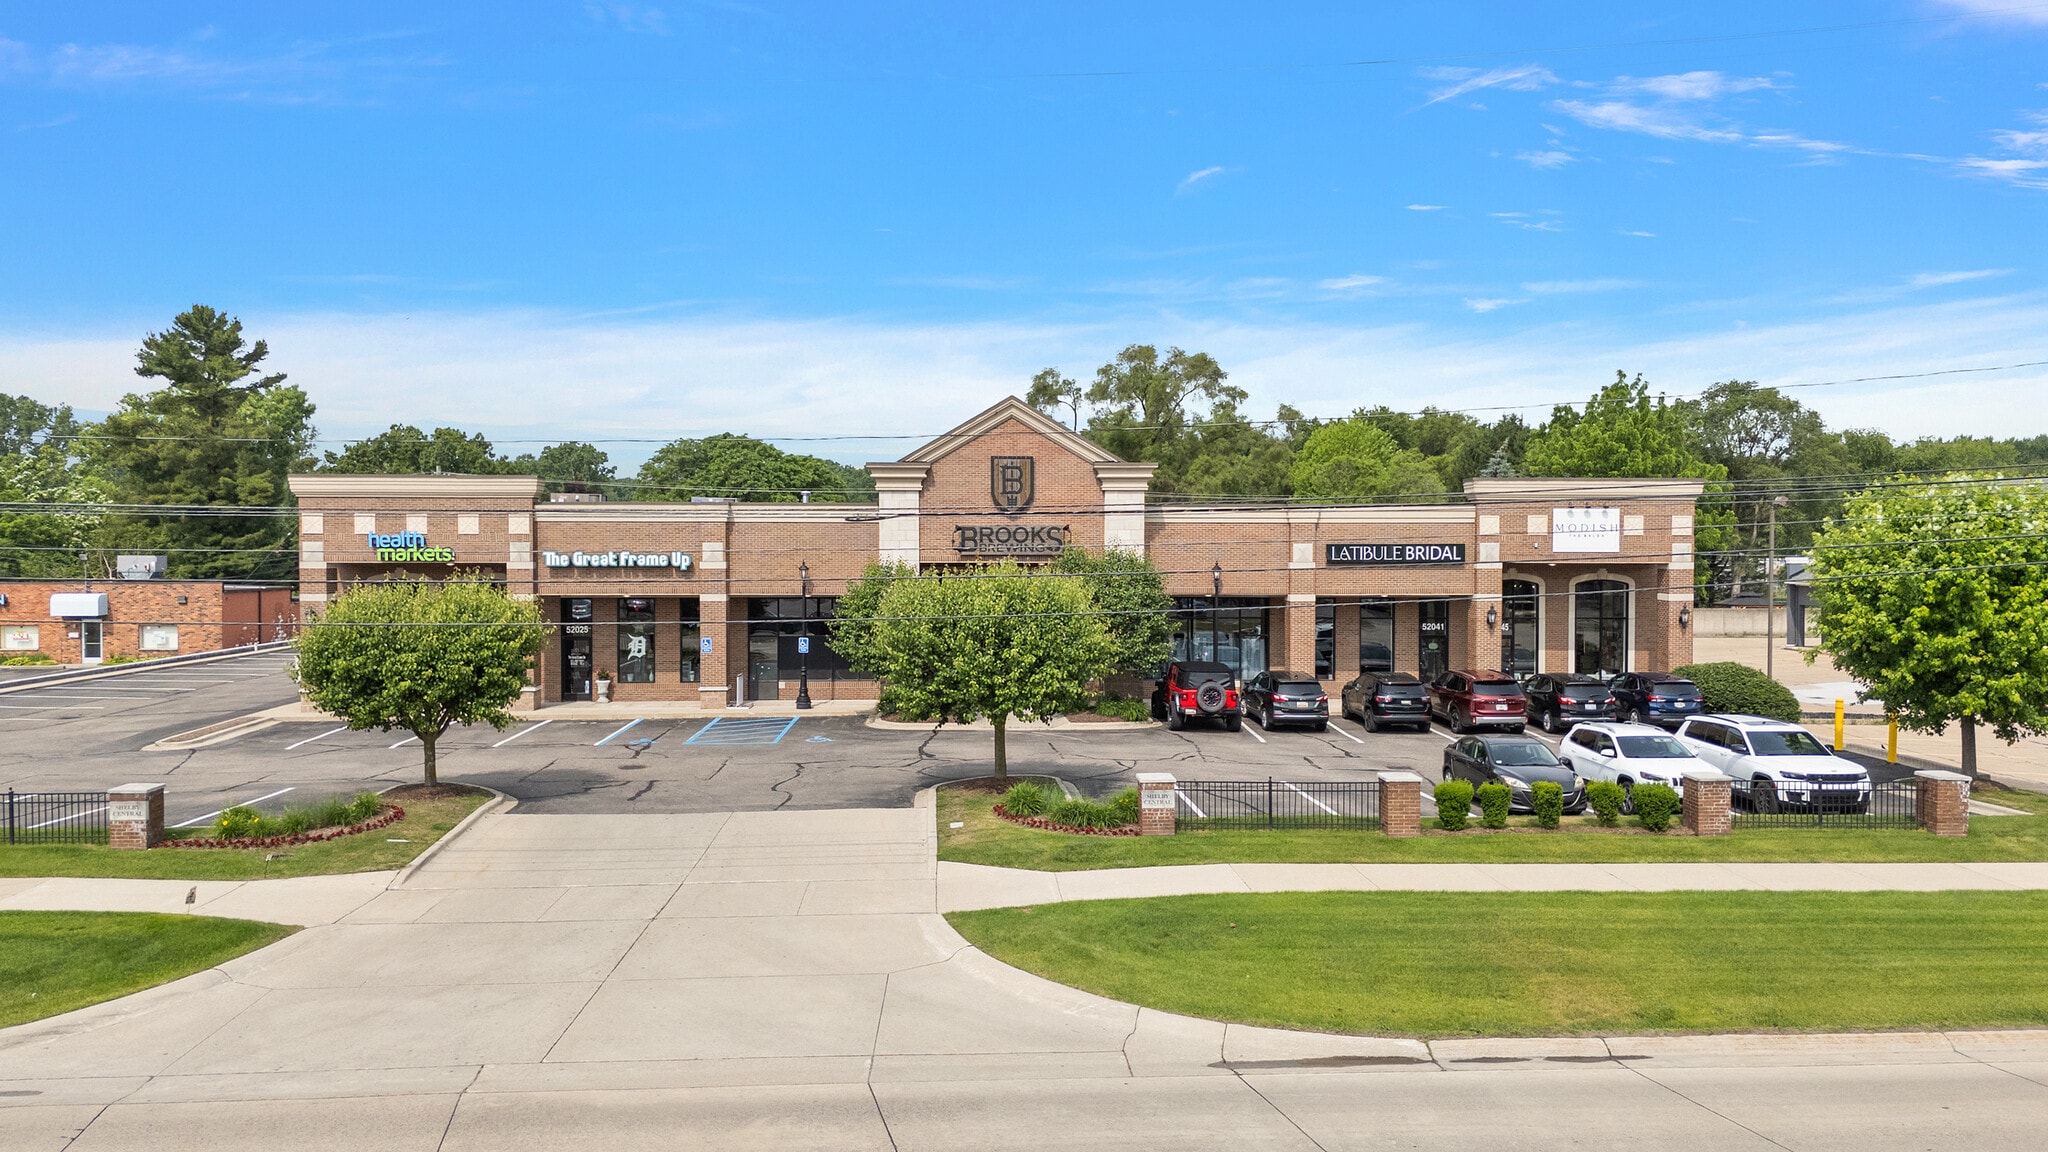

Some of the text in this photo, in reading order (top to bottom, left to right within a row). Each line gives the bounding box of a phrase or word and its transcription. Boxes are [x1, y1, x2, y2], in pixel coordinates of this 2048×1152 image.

[1555, 523, 1618, 532] MODISH
[367, 529, 425, 548] health
[960, 526, 1063, 552] BROOKS
[376, 544, 455, 562] markets
[979, 543, 1046, 553] BREWING
[1331, 546, 1461, 560] LATIBULE BRIDAL
[542, 551, 692, 571] The Great Frame Up
[566, 625, 589, 634] 52025
[1421, 622, 1445, 631] 52041
